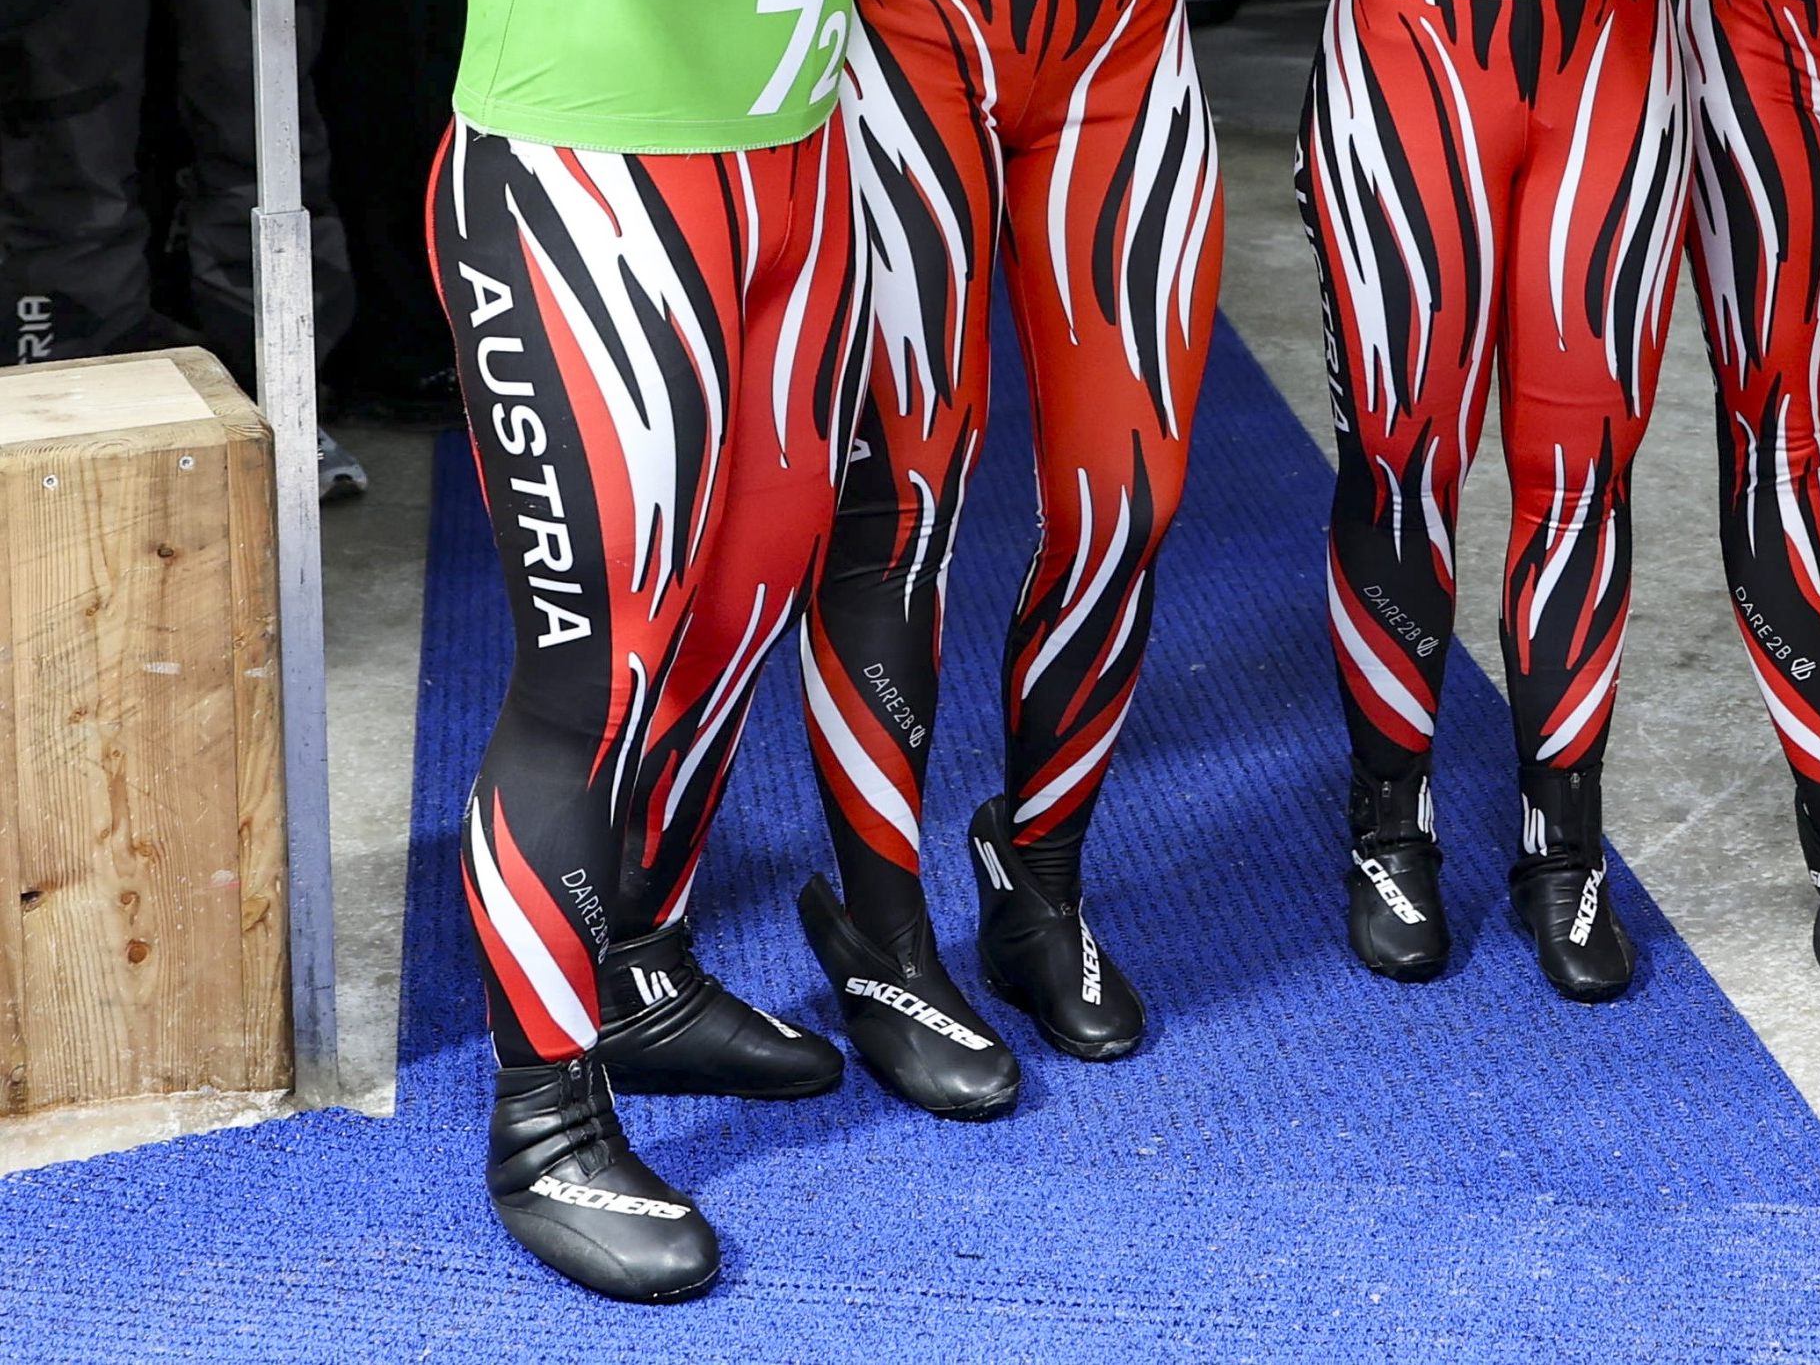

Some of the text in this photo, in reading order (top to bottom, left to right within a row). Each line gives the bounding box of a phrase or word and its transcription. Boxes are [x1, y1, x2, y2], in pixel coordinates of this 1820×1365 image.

[457, 260, 592, 649] AUSTRIA
[1364, 585, 1420, 642] DARE2B
[1736, 587, 1793, 661] DARE2B
[863, 663, 917, 731] DARE2B
[844, 976, 995, 1052] SKECHERS
[529, 1175, 691, 1220] SKECHERS
